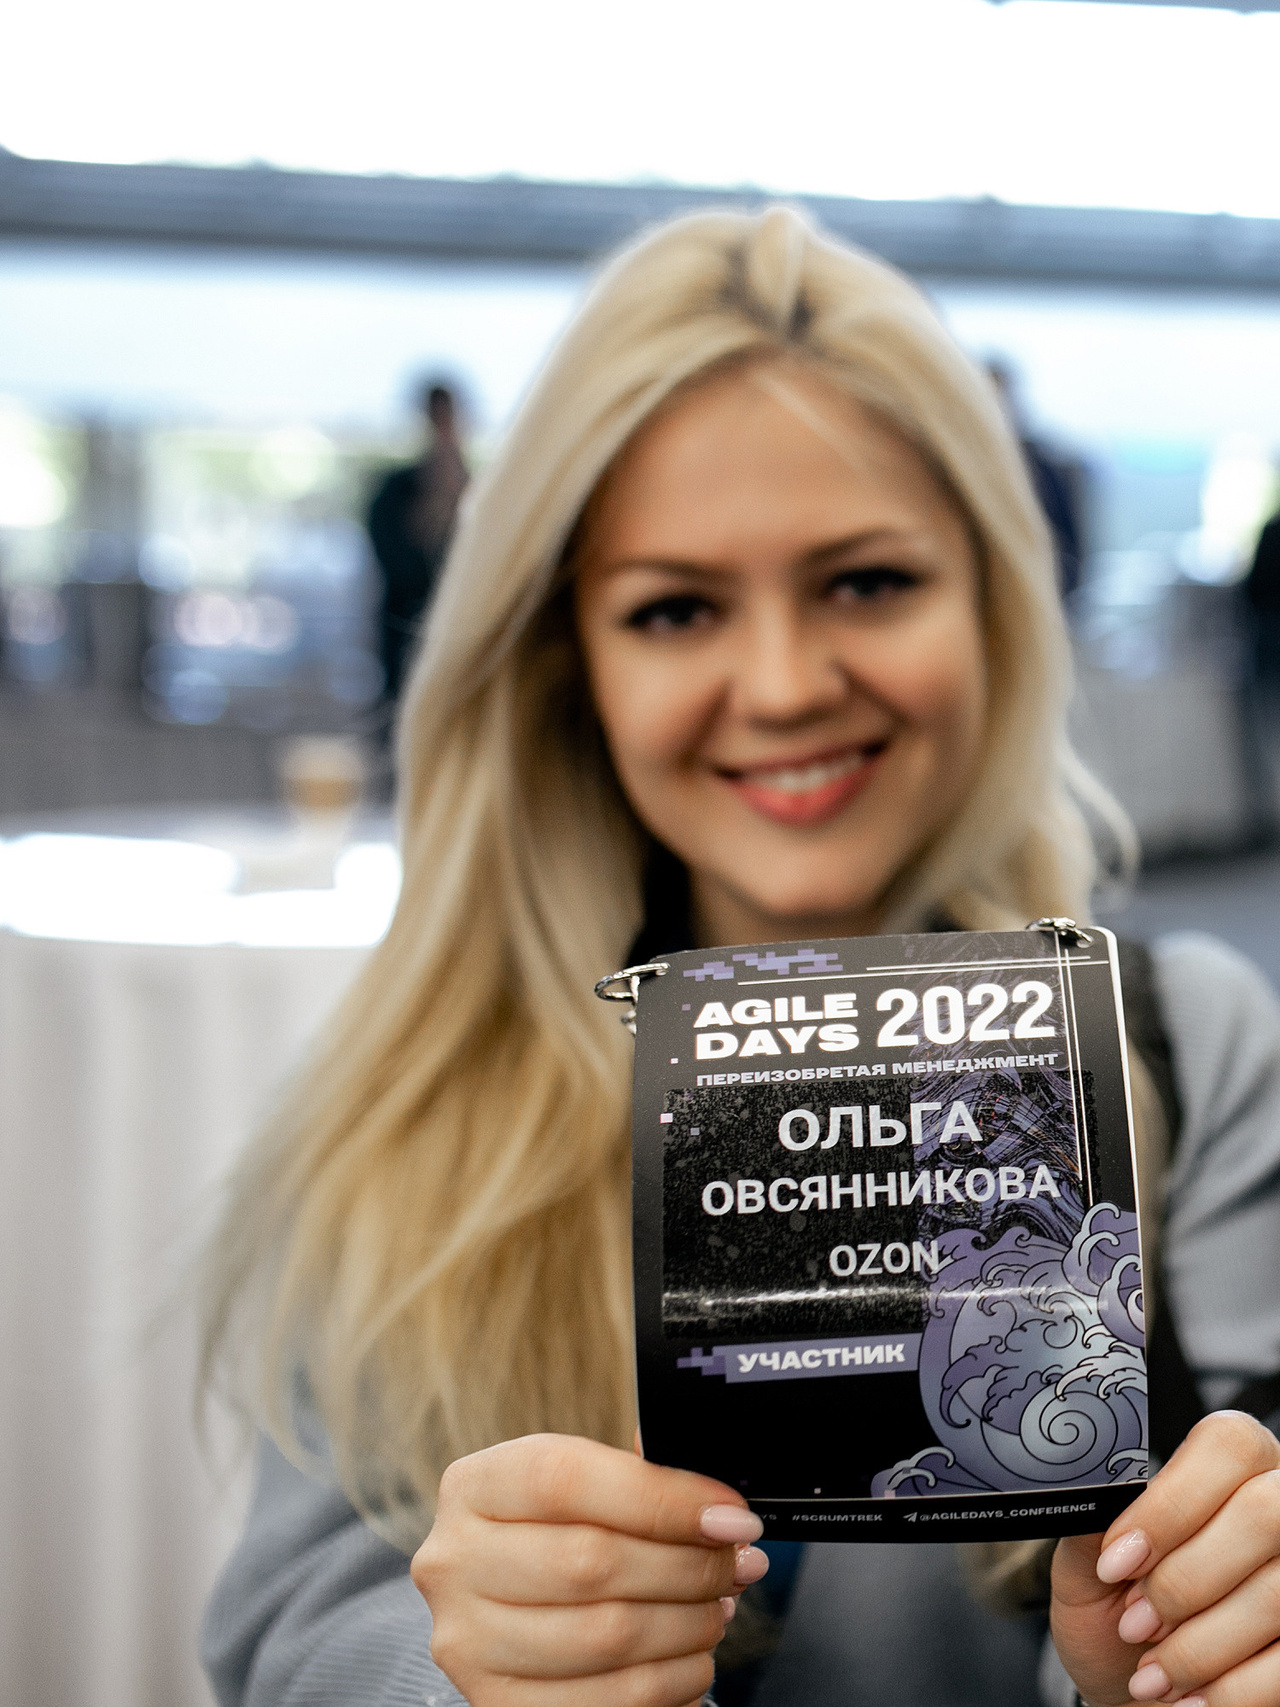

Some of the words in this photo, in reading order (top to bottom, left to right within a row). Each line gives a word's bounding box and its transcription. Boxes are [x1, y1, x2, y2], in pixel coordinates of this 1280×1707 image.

[693, 992, 858, 1028] AGILE
[877, 981, 1055, 1048] 2022
[696, 1023, 859, 1060] DAYS
[697, 1063, 886, 1086] ПЕРЕИЗОБРЕТАЯ
[892, 1053, 1059, 1075] МЕНЕДЖМЕНТ
[778, 1100, 983, 1151] ОЛЬГА
[701, 1164, 1062, 1217] ОВСЯННИКОВА
[829, 1240, 941, 1277] OZON
[737, 1343, 906, 1374] УЧАСТНИК
[792, 1512, 884, 1523] #SCRUMTREK
